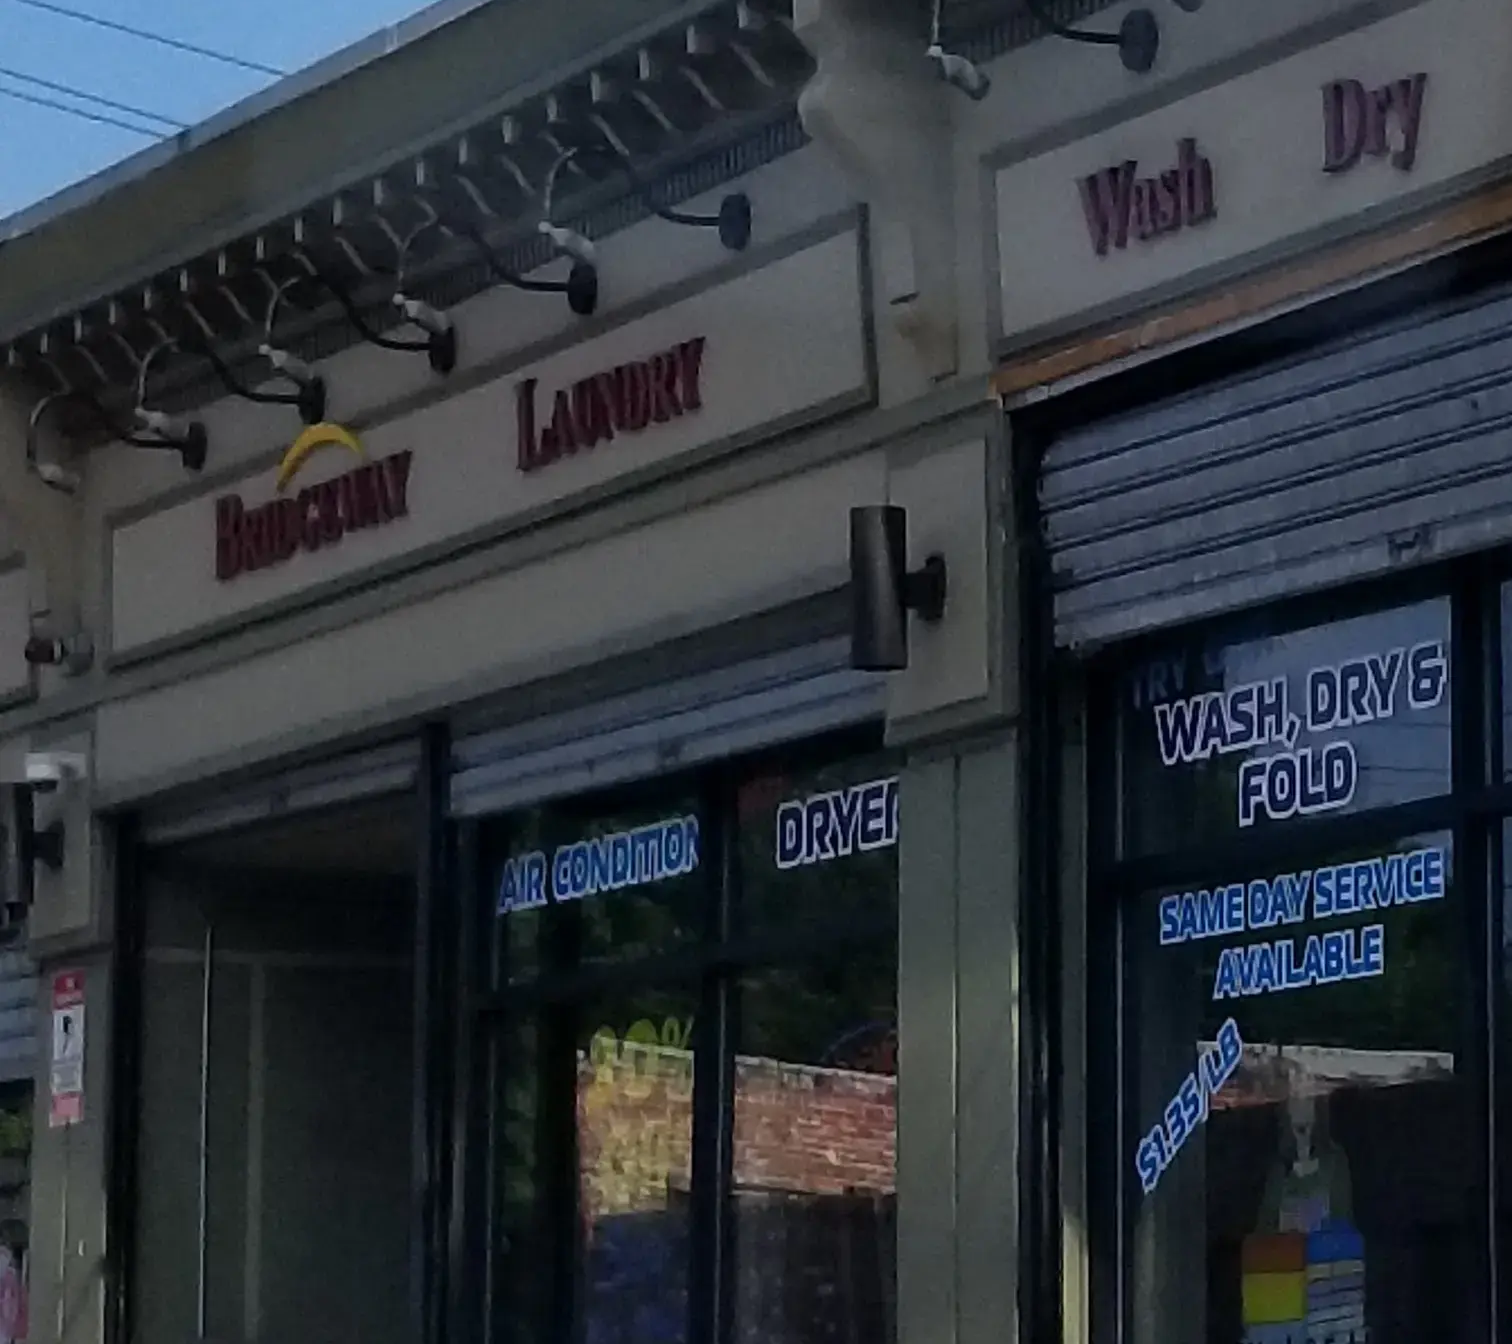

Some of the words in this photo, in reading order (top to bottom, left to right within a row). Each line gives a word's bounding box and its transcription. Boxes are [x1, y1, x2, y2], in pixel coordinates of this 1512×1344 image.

[1076, 137, 1217, 256] Wash
[1322, 72, 1427, 173] Dry
[1153, 675, 1301, 767] WASH,
[1307, 647, 1405, 732] DRY
[1408, 640, 1447, 709] &
[1238, 741, 1357, 828] FOLD
[496, 849, 548, 916] AIR
[1159, 883, 1245, 946] SAME
[1248, 869, 1312, 930] DAY
[1311, 846, 1446, 920] SERVICE
[1212, 923, 1385, 1001] AVAILABLE
